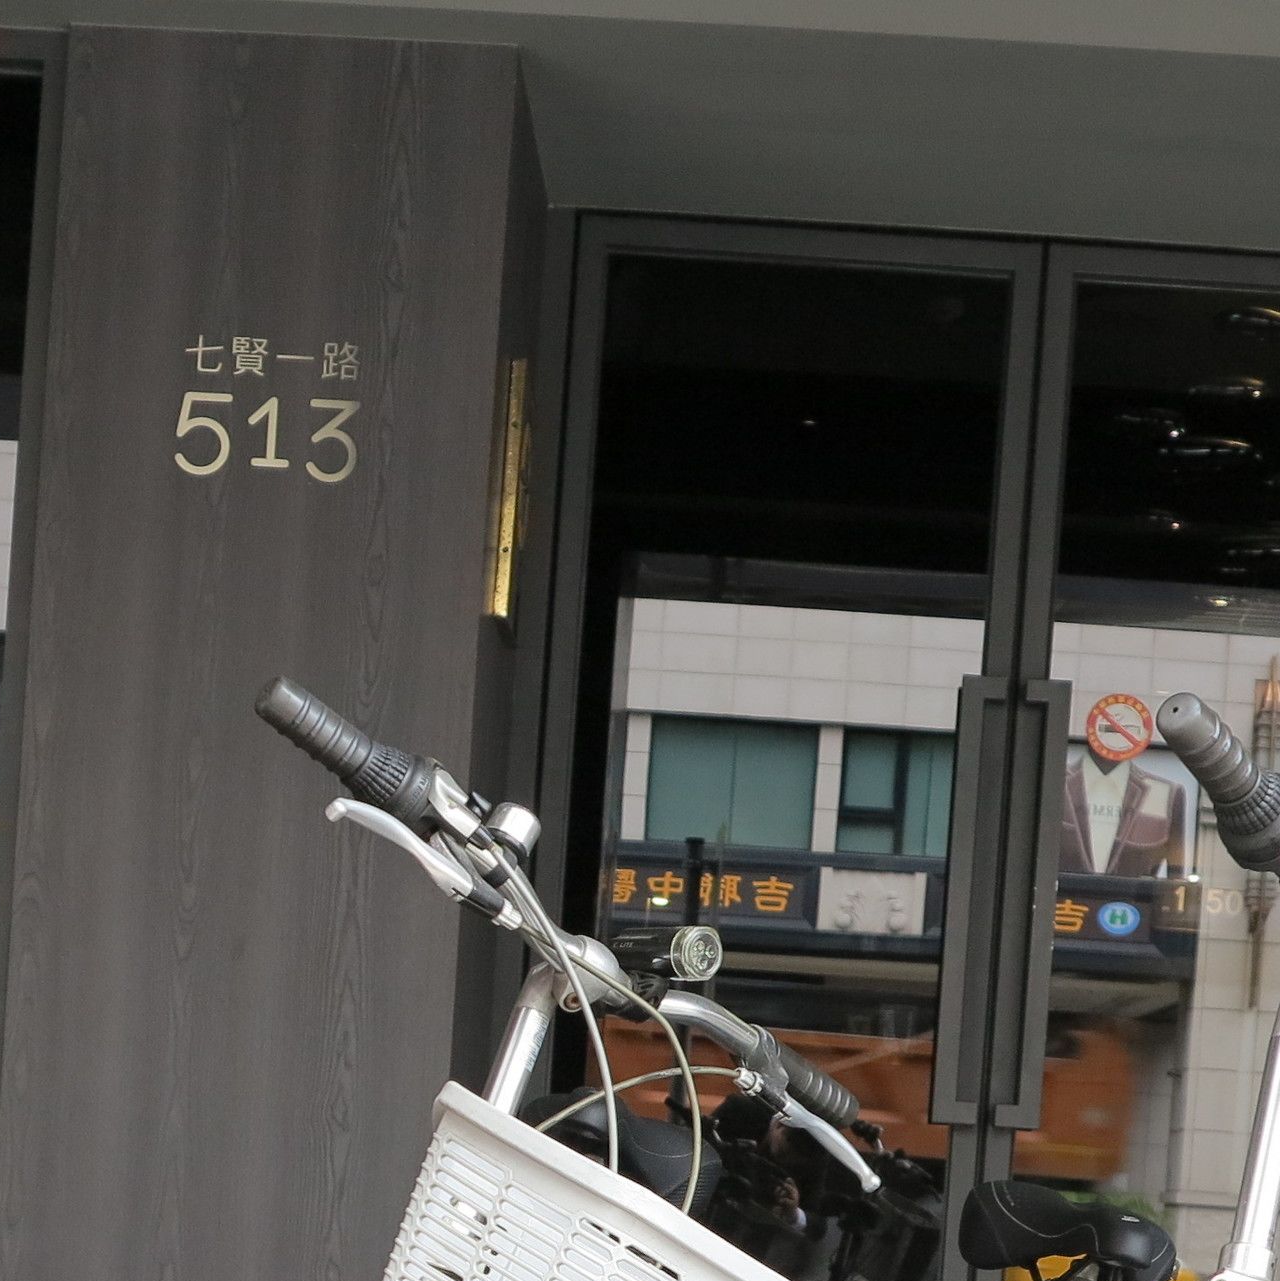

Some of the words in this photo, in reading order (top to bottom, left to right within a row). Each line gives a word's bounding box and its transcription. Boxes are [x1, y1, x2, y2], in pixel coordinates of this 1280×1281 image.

[185, 334, 361, 381] 七賢一路
[174, 390, 361, 483] 513
